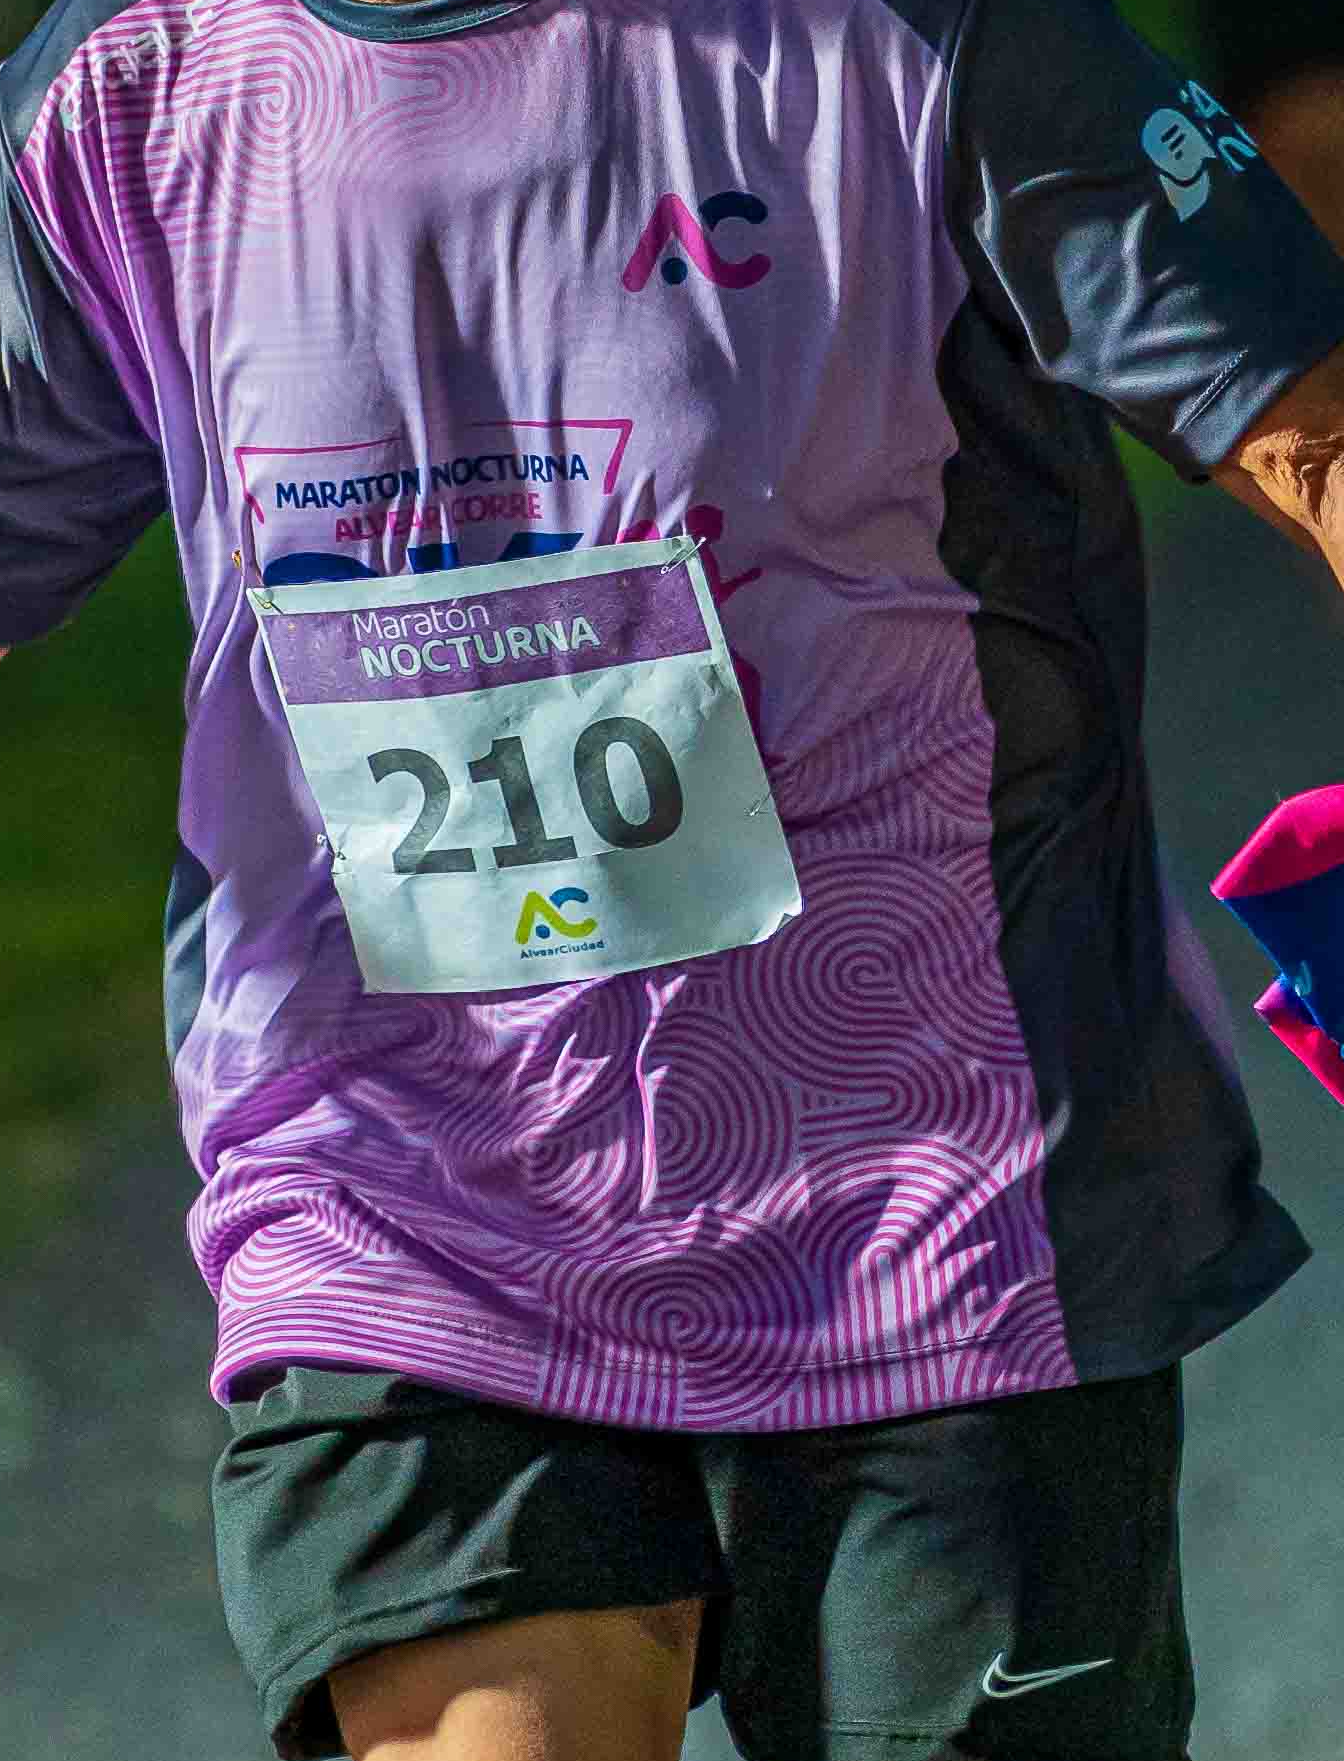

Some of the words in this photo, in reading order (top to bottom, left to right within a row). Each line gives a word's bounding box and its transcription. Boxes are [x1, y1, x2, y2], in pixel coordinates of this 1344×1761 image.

[275, 466, 423, 510] MARATON
[430, 453, 590, 490] NOCTURNA
[452, 492, 544, 523] CORRE
[352, 598, 490, 642] Maratón
[359, 615, 601, 680] NOCTURNA
[367, 716, 685, 874] 210
[520, 939, 605, 959] AlvearCiudad
